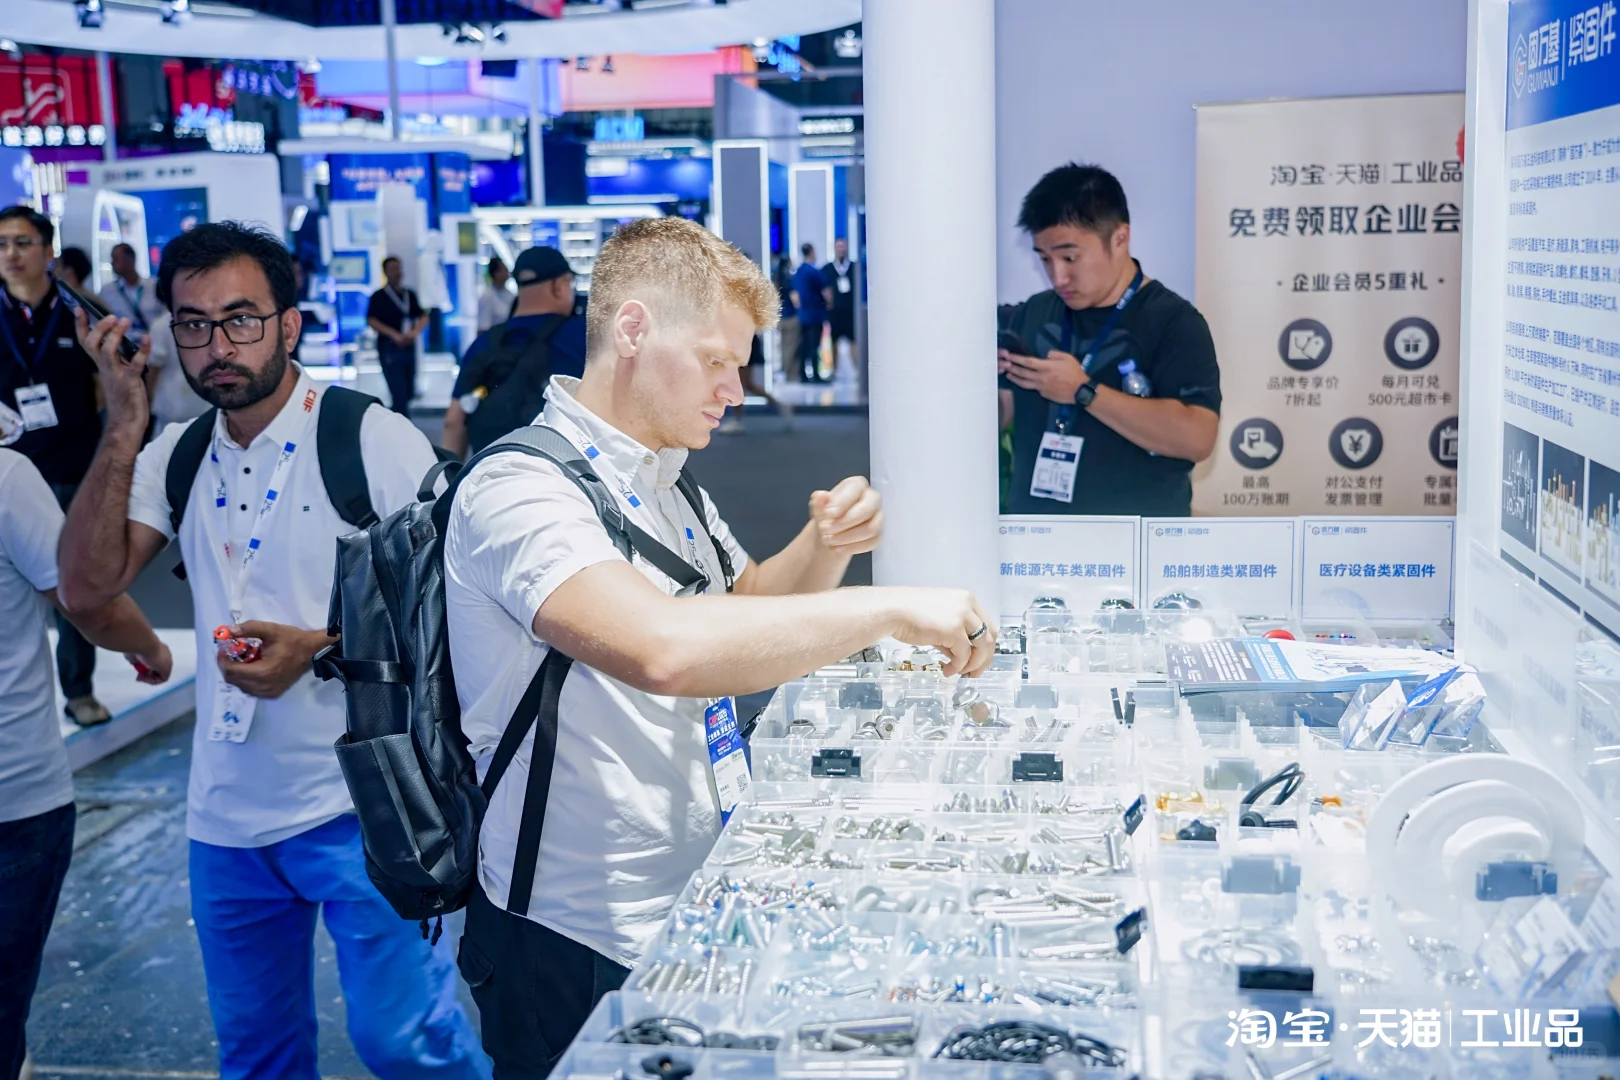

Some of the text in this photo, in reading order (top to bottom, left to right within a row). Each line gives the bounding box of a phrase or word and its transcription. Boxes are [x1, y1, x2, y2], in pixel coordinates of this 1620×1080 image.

[1568, 0, 1617, 67] 紧固件
[1390, 160, 1463, 184] 工业品
[1229, 203, 1460, 238] 免费领取企业会
[1266, 376, 1339, 391] 品牌专享价
[1382, 375, 1440, 389] 每月可兑
[1285, 393, 1321, 407] 7折起
[1368, 392, 1452, 407] 500元超市卡
[1242, 476, 1270, 490] 最高
[1325, 475, 1383, 490] 对公支付
[1424, 475, 1457, 489] 专属
[1222, 493, 1290, 507] 100万账期
[1325, 493, 1383, 507] 发票管理
[1424, 493, 1457, 507] 批量
[1000, 563, 1126, 578] 新能源汽车类紧固件
[1163, 564, 1277, 578] 船舶制造类紧固件
[1319, 563, 1436, 578] 医疗设备类紧固件
